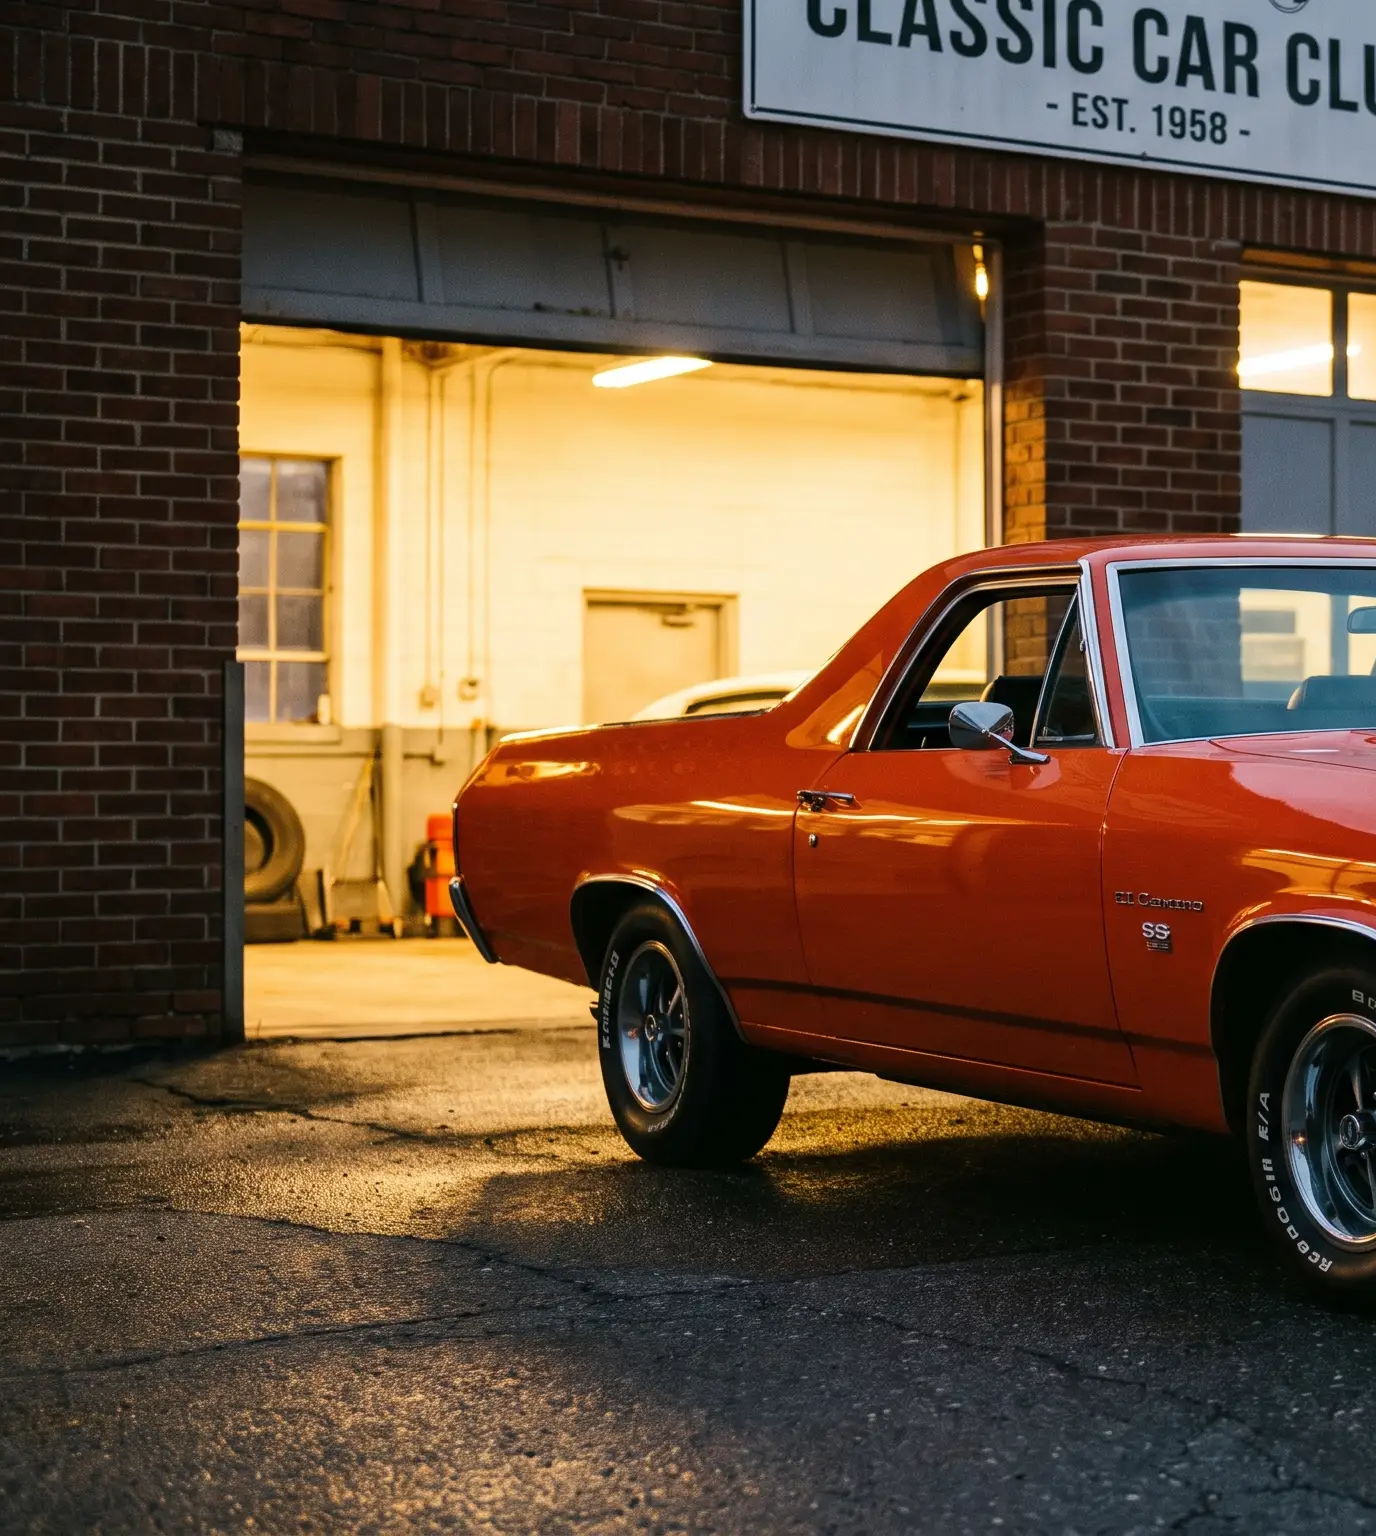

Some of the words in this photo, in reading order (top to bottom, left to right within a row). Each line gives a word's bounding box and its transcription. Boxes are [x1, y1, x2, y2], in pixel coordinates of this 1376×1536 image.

[1132, 7, 1260, 98] CAR
[1072, 91, 1136, 133] EST.
[1151, 104, 1227, 145] 1958
[1141, 921, 1171, 940] SS
